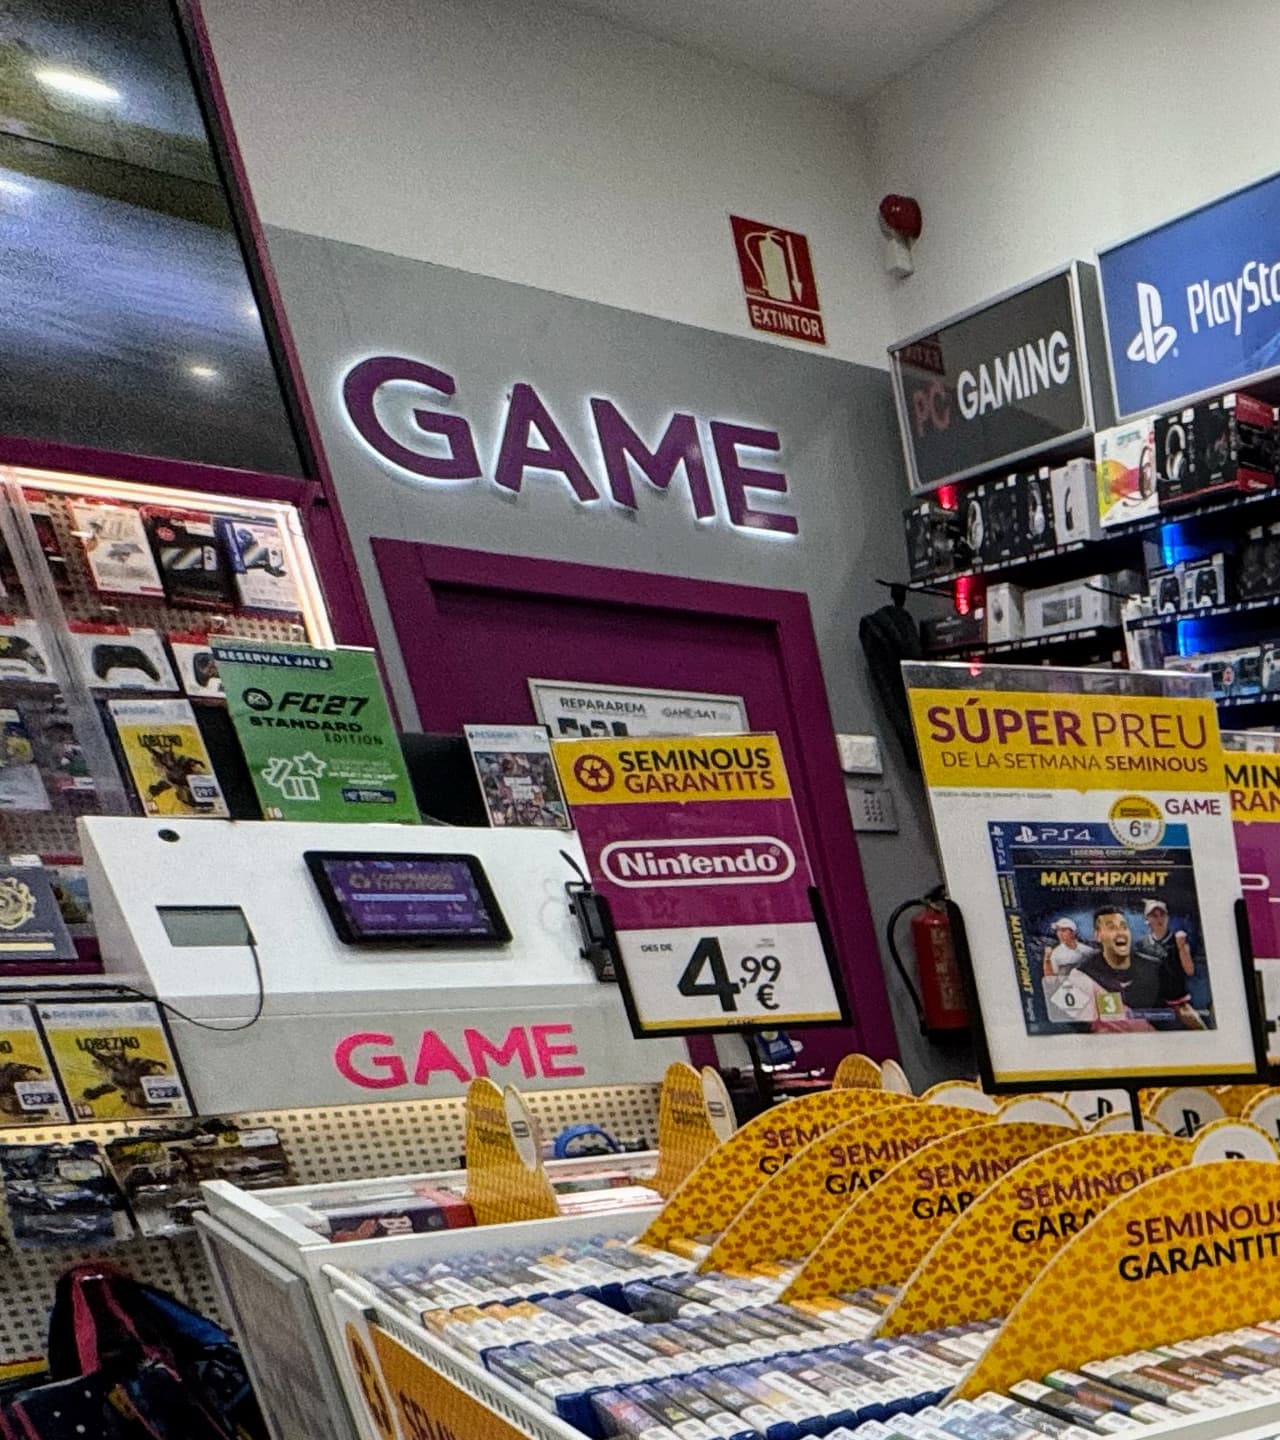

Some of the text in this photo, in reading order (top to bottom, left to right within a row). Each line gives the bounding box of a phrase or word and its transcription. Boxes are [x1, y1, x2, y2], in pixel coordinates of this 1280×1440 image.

[751, 304, 822, 339] EXTINTOR
[914, 330, 1070, 436] PC GAMING
[343, 356, 799, 534] GAME
[219, 650, 298, 667] RESERVA'L
[277, 692, 370, 716] FC27
[560, 697, 645, 714] REPARAREM
[249, 716, 363, 733] STANDARD
[927, 698, 1207, 750] SÚPER PREU
[324, 732, 384, 746] EDITION
[618, 748, 771, 772] SEMINOUS
[941, 751, 1208, 772] DE LA SETMANA SEMINOUS
[624, 769, 776, 794] GARANTITS
[1165, 798, 1222, 816] GAME
[1040, 828, 1092, 841] PS4
[617, 848, 777, 877] Nintendo
[1040, 871, 1168, 887] MATCHPOINT
[677, 937, 781, 1012] 4,99
[335, 1024, 585, 1089] GAME
